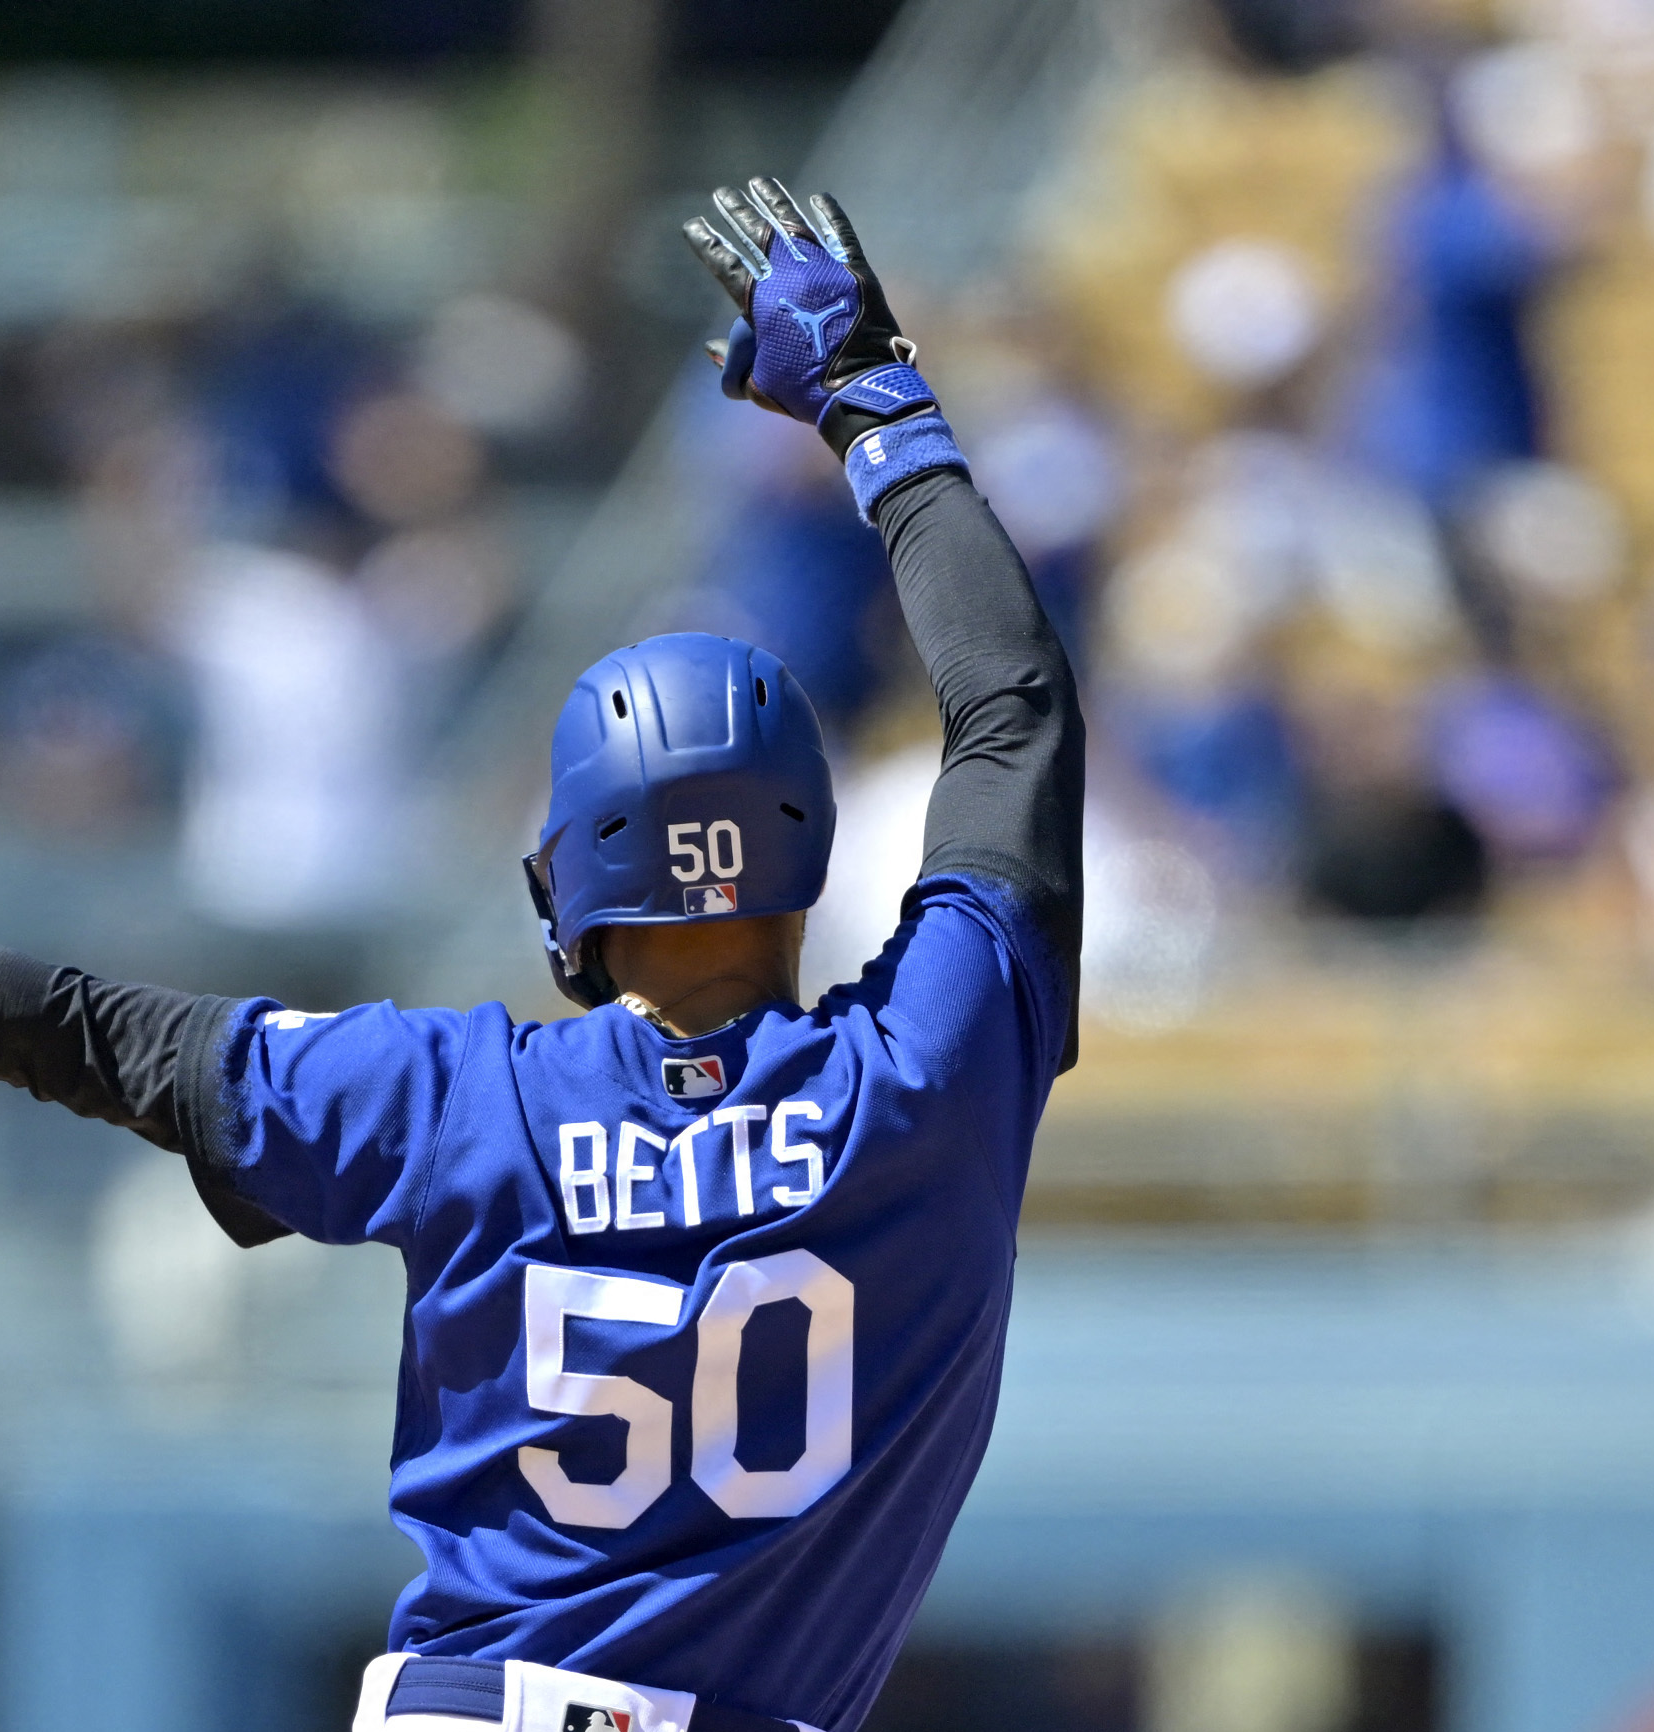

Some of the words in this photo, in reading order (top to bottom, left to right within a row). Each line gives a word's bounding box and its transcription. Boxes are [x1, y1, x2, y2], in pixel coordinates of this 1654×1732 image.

[666, 819, 744, 883] 50
[559, 1100, 824, 1235] BETTS
[518, 1248, 854, 1529] 50
